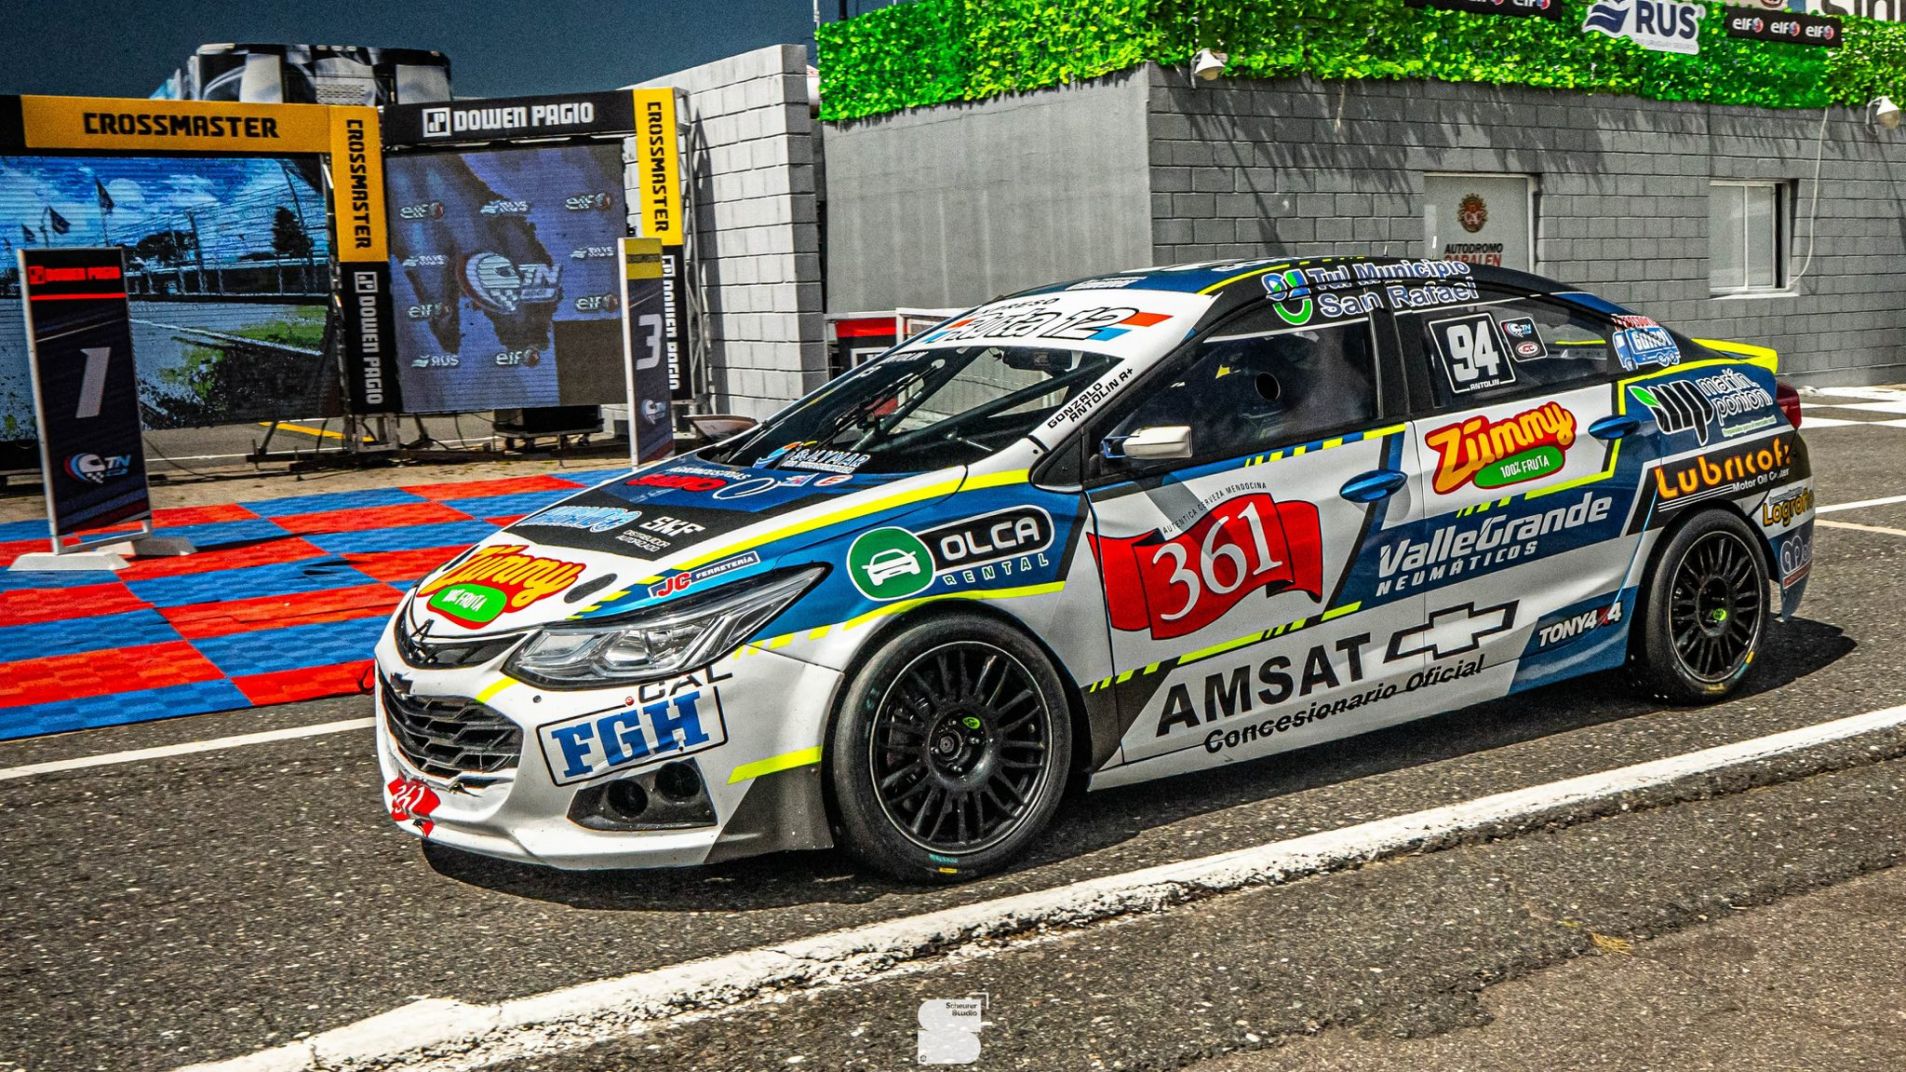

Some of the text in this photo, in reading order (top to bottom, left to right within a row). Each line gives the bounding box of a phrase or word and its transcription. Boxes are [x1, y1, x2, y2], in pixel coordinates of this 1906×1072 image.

[1636, 0, 1697, 40] RUS
[1732, 18, 1824, 38] elf elf elf
[84, 112, 279, 138] CROSSMASTER
[453, 102, 594, 132] DOWEN PAGIO
[346, 119, 372, 249] CROSSMASTER
[647, 101, 669, 233] CROSSMASTER
[1444, 243, 1504, 254] AUTODROMO
[518, 263, 561, 287] TN
[1352, 259, 1471, 285] Municipio
[1318, 277, 1479, 318] San Rafael
[359, 296, 383, 405] DOWEN PAGIO
[636, 313, 663, 371] 3
[1446, 320, 1500, 382] 94
[75, 347, 111, 419] 1
[1047, 382, 1103, 429] GONZALO
[1069, 368, 1133, 422] ANTOLIN A+
[1469, 379, 1500, 391] ANTOLIN
[1500, 455, 1550, 479] 100% FRUTA
[1732, 478, 1756, 493] Motor
[638, 516, 706, 537] SKF
[1163, 482, 1267, 534] AUTENTICA CERVEZA MENDOCINA
[940, 516, 1040, 561] OLCA
[1379, 492, 1613, 578] ValleGrande
[656, 553, 756, 599] JC FERRETERÍA
[942, 552, 1049, 585] RENTAL
[1152, 501, 1283, 621] 361
[1375, 541, 1539, 597] NEUMÁTICOS
[456, 591, 488, 612] FRUTA
[1155, 632, 1371, 737] AMSAT
[1204, 654, 1486, 753] Concesionario Oficial
[551, 691, 710, 778] FGH
